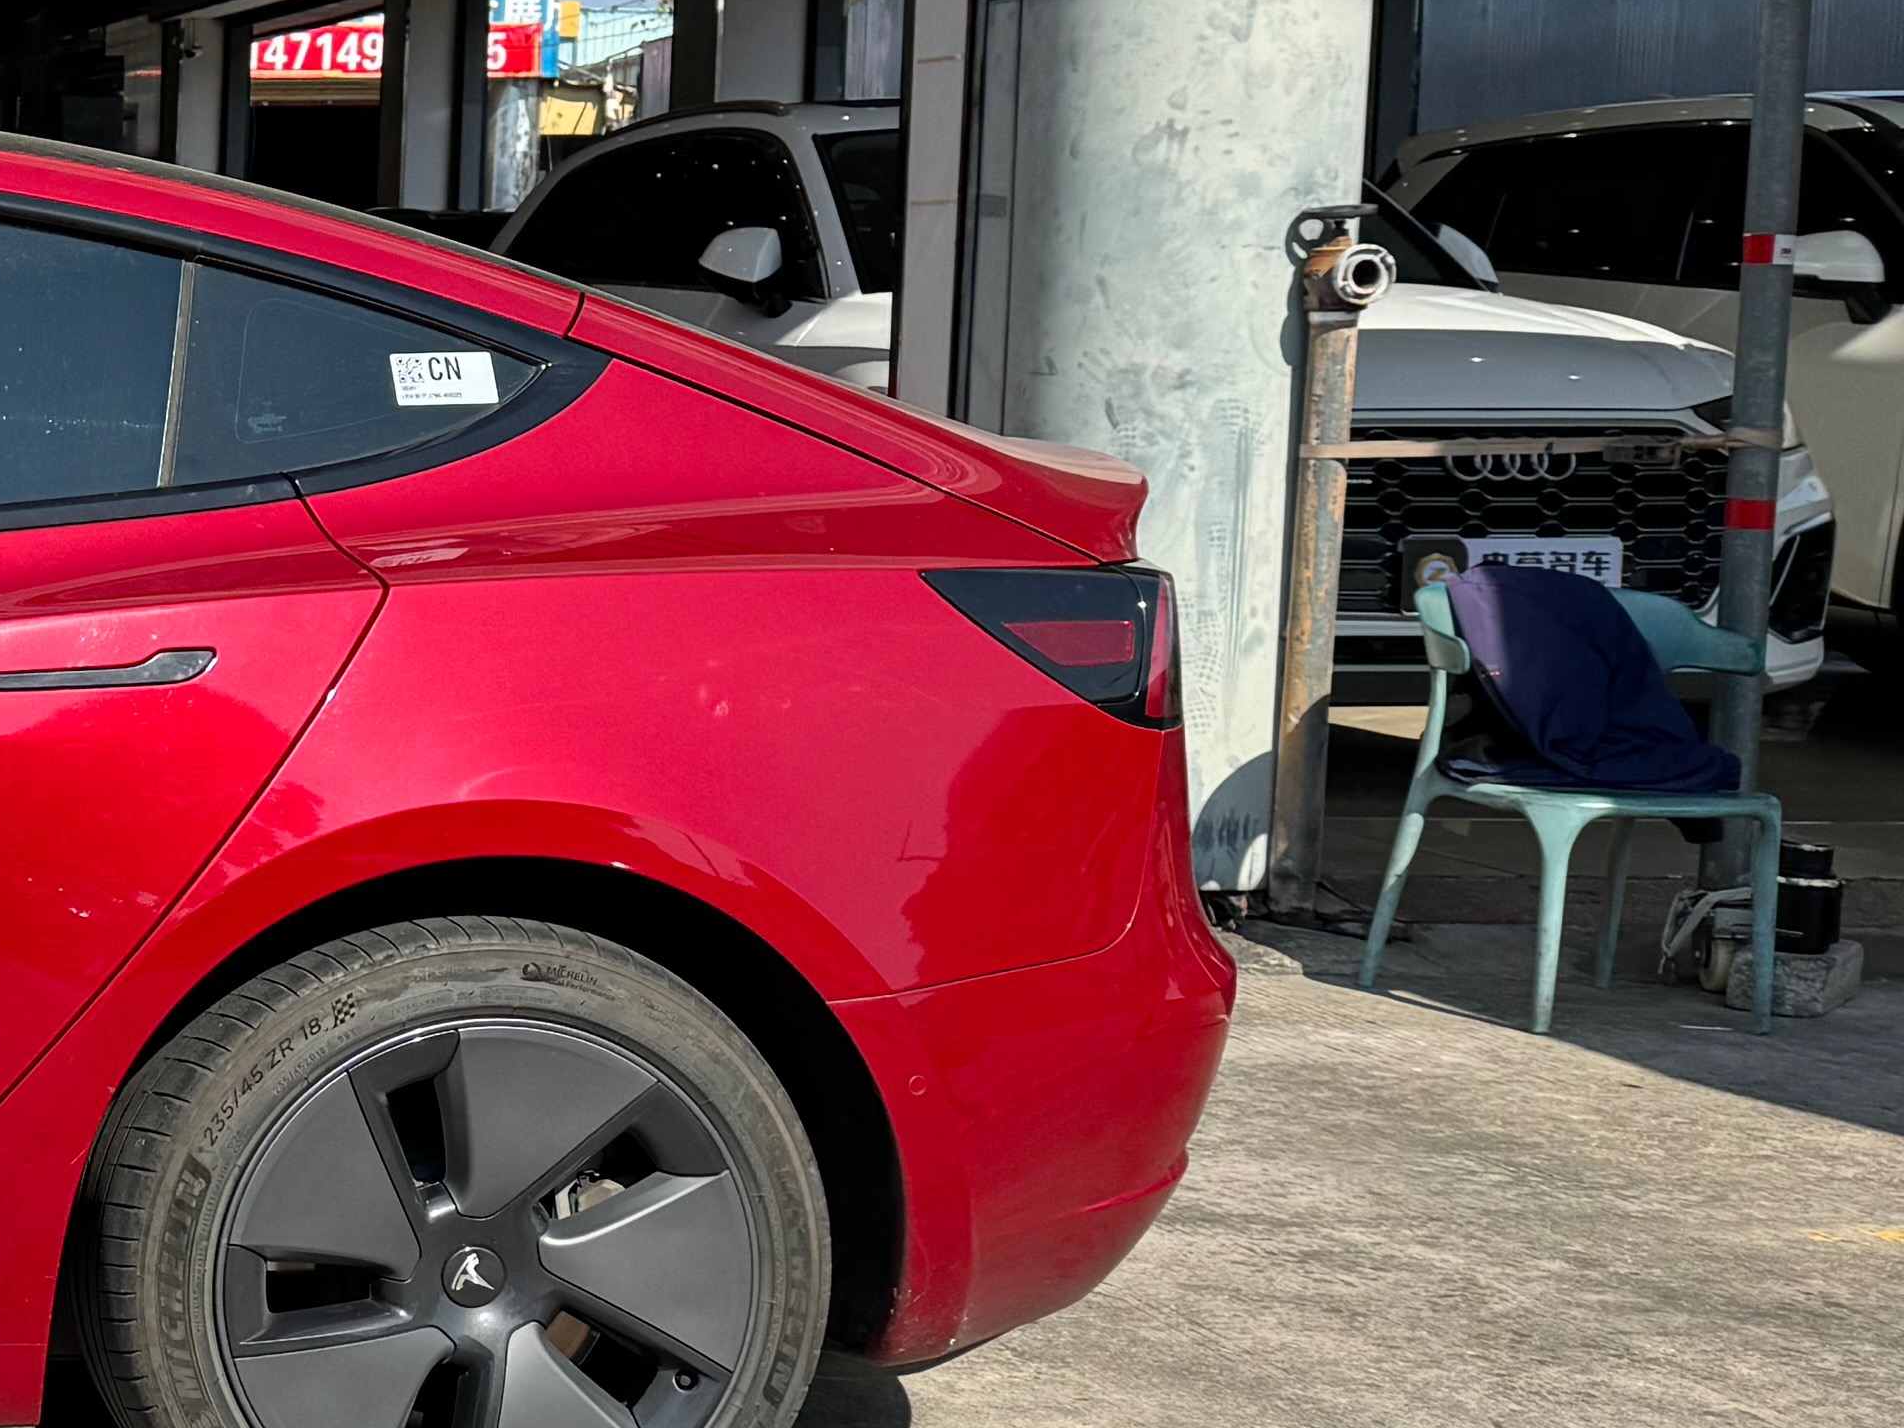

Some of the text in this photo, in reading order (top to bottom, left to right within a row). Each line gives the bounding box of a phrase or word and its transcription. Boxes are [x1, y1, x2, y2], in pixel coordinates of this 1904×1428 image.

[428, 356, 462, 381] CN
[203, 1017, 322, 1147] 235/45 ZR 18
[160, 1167, 207, 1400] MICHELIN
